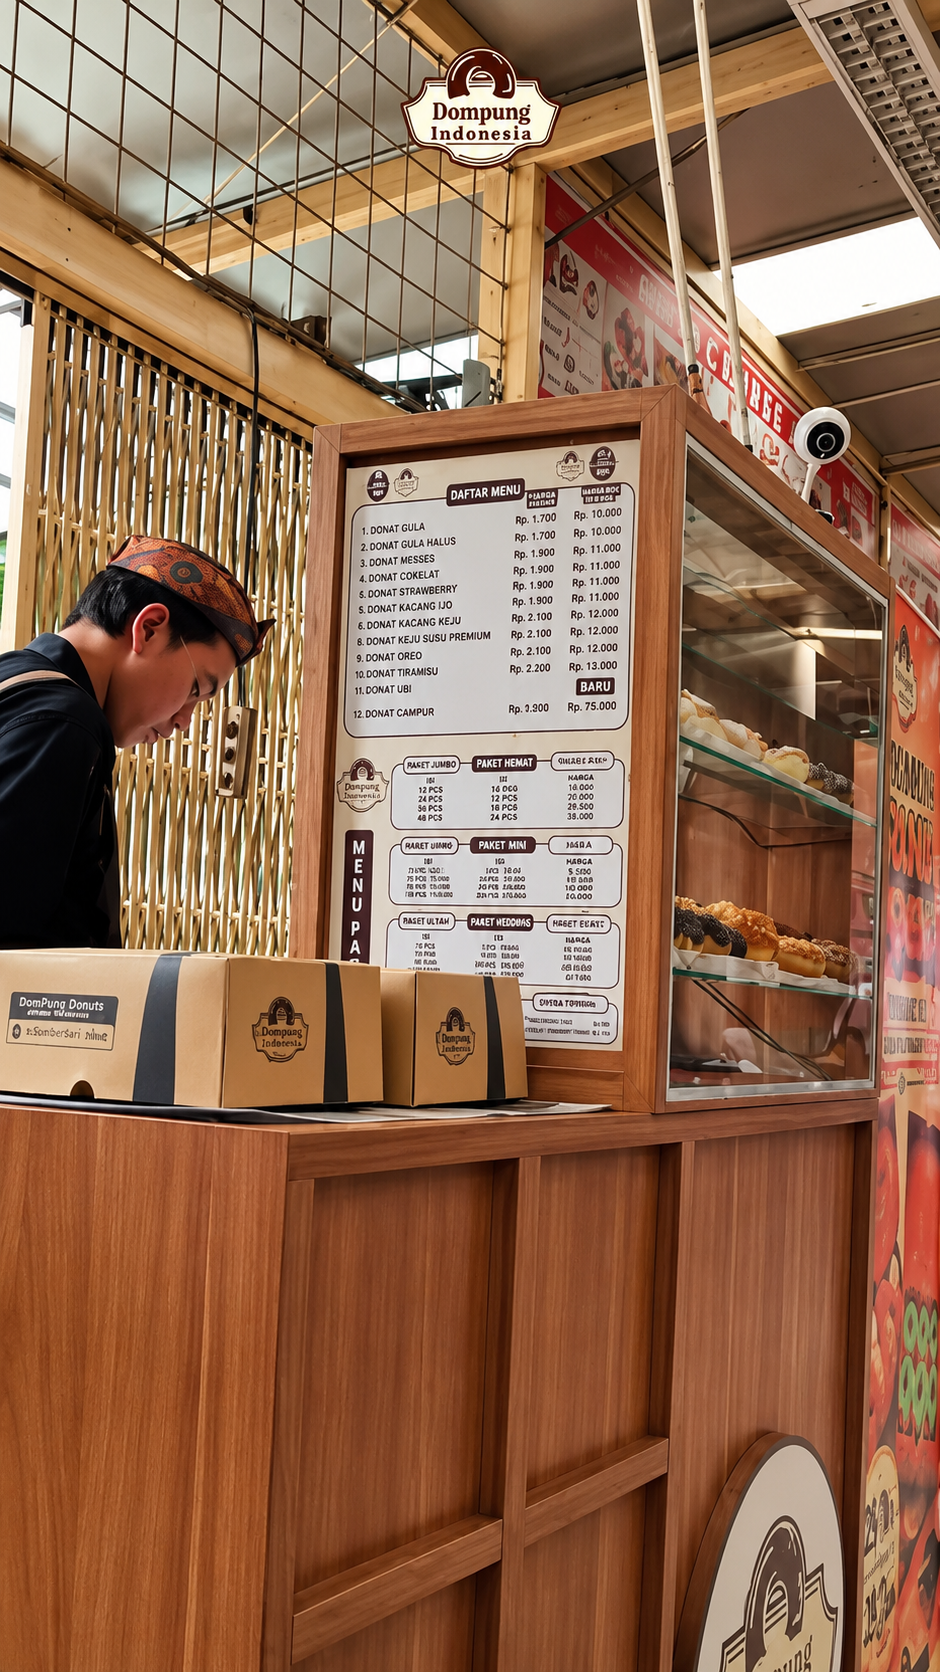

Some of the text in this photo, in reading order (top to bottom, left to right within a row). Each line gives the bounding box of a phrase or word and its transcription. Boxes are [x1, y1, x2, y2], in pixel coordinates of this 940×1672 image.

[451, 484, 521, 500] DAFTAR MENU
[370, 524, 399, 535] DONAT
[402, 522, 425, 533] GULA
[515, 515, 529, 525] Rp.
[532, 513, 556, 524] 1.700
[574, 511, 589, 520] Rp.
[591, 508, 622, 519] 10.000
[370, 541, 398, 551] DONAT
[401, 539, 424, 549] GULA
[427, 537, 456, 548] HALUS
[515, 533, 529, 543] Rp.
[532, 530, 556, 541] 1.700
[574, 528, 588, 538] Rp.
[591, 525, 621, 536] 10.000
[369, 557, 398, 567] DONAT
[400, 554, 435, 565] MESSES
[514, 550, 528, 560] Rp.
[531, 548, 555, 558] 1.900
[573, 546, 587, 556] Rp.
[590, 543, 621, 554] 11.000
[369, 572, 397, 583] DONAT
[400, 570, 439, 581] COKELAT
[513, 566, 528, 576] Rp.
[530, 564, 554, 574] 1.900
[573, 563, 587, 573] Rp.
[590, 560, 620, 571] 11.000
[368, 588, 397, 598] DONAT
[399, 585, 458, 596] STRAWBERRY
[513, 582, 527, 591] Rp.
[530, 579, 554, 590] 1.900
[572, 579, 586, 589] Rp.
[589, 576, 620, 587] 11.000
[367, 604, 396, 614] DONAT
[399, 602, 436, 612] KACANG
[438, 601, 453, 610] IJO
[512, 597, 527, 607] Rp.
[529, 595, 553, 606] 1.900
[571, 594, 586, 604] Rp.
[589, 592, 619, 603] 11.000
[367, 619, 396, 629] DONAT
[399, 618, 436, 628] KACANG
[438, 616, 461, 626] KEJU
[511, 613, 526, 623] Rp.
[528, 612, 552, 622] 2.100
[571, 611, 585, 620] Rp.
[588, 608, 619, 619] 12.000
[366, 636, 395, 646] DONAT
[398, 634, 420, 645] KEJU
[423, 633, 447, 643] SUSU
[449, 631, 491, 642] PREMIUM
[511, 630, 525, 640] Rp.
[527, 628, 552, 638] 2.100
[570, 627, 584, 636] Rp.
[588, 625, 618, 635] 12.000
[366, 652, 395, 662] DONAT
[398, 651, 422, 661] OREO
[510, 647, 525, 657] Rp.
[526, 645, 551, 655] 2.100
[569, 645, 584, 654] Rp.
[587, 642, 618, 653] 12.000
[367, 668, 395, 678] DONAT
[398, 666, 439, 677] TIRAMISU
[510, 664, 524, 674] Rp.
[526, 662, 551, 672] 2.200
[569, 662, 583, 672] Rp.
[586, 660, 617, 671] 13.000
[355, 684, 411, 694] 11. DONAT UBI
[581, 681, 610, 692] BARU
[365, 708, 394, 718] DONAT
[397, 707, 434, 717] CAMPUR
[508, 704, 523, 714] Rp.
[567, 702, 582, 712] Rp.
[585, 700, 617, 711] 75.000
[431, 760, 456, 769] JUMBO
[476, 757, 533, 768] PAKET HEMAT
[429, 795, 443, 803] PCS
[502, 794, 518, 802] PCS
[428, 814, 443, 822] PCS
[502, 813, 518, 821] PCS
[479, 840, 526, 850] PAKET MINI
[69, 999, 104, 1011] Donuts
